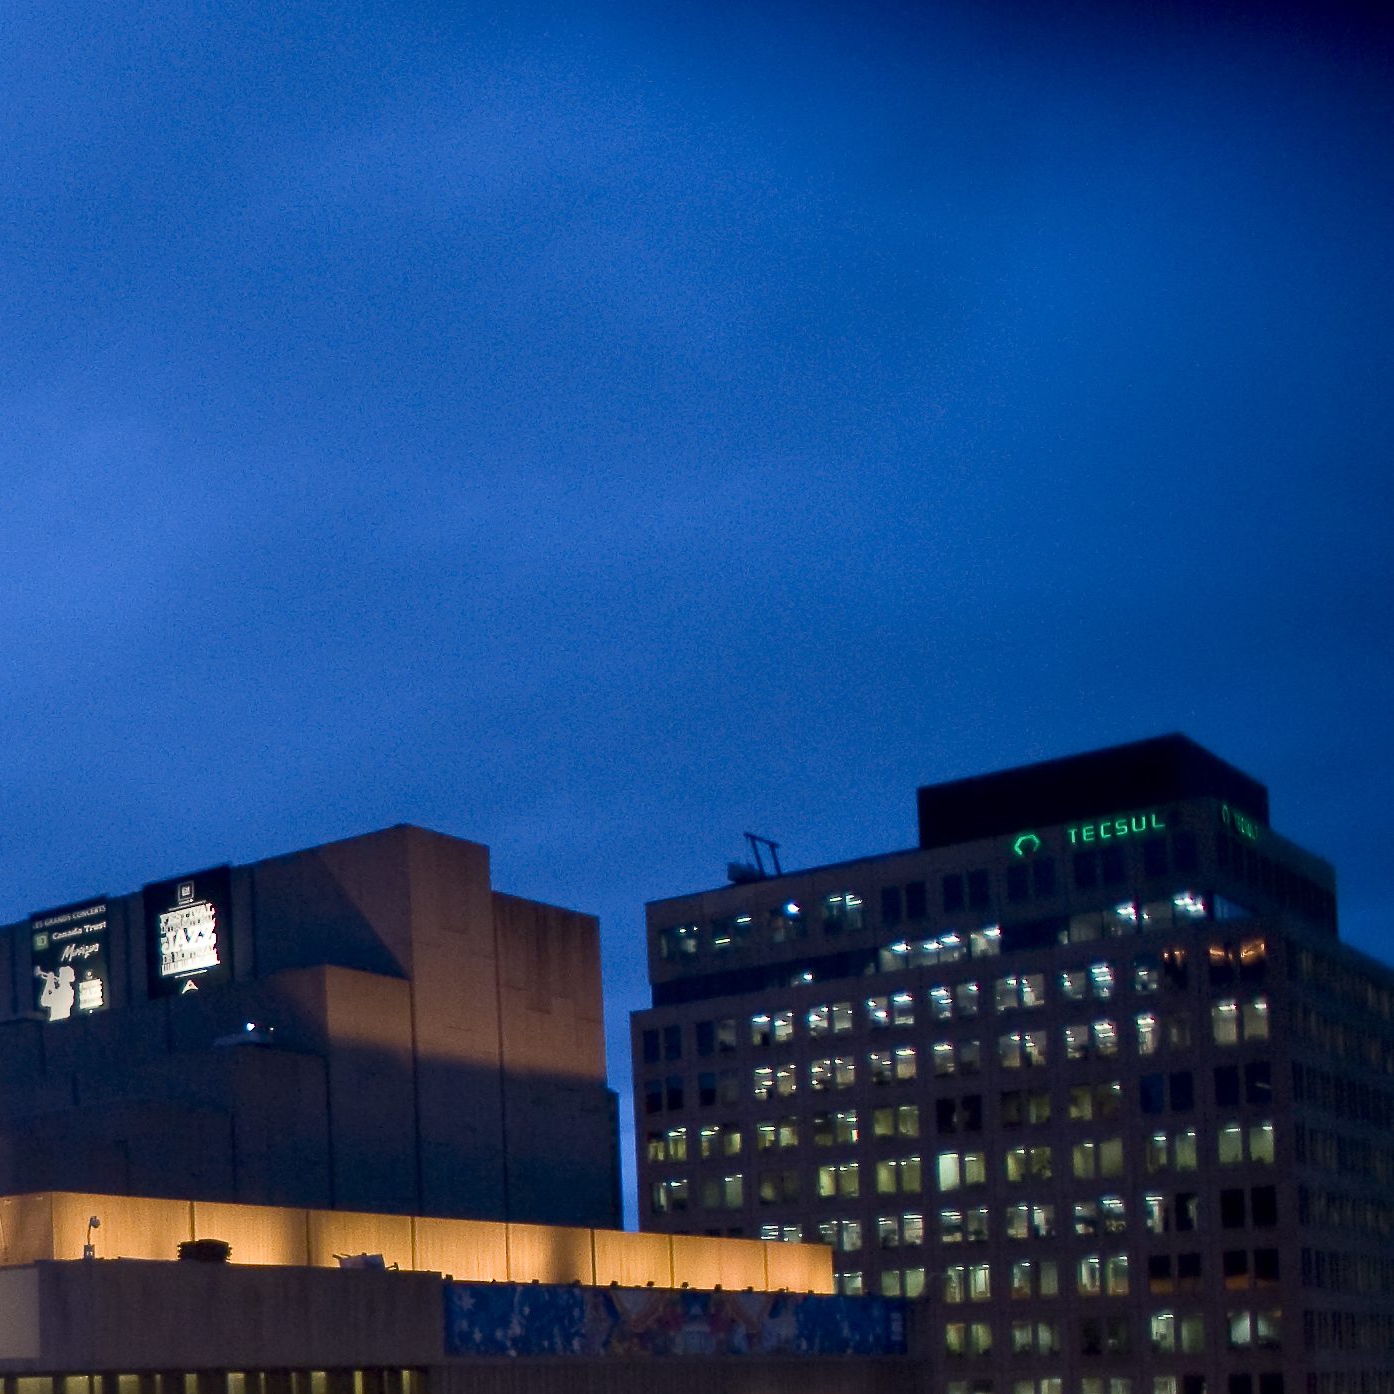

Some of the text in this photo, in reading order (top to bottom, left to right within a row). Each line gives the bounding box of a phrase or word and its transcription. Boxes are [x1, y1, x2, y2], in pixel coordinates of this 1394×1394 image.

[1068, 813, 1165, 844] TECSUL
[52, 928, 83, 940] Canada
[83, 921, 107, 933] Trust
